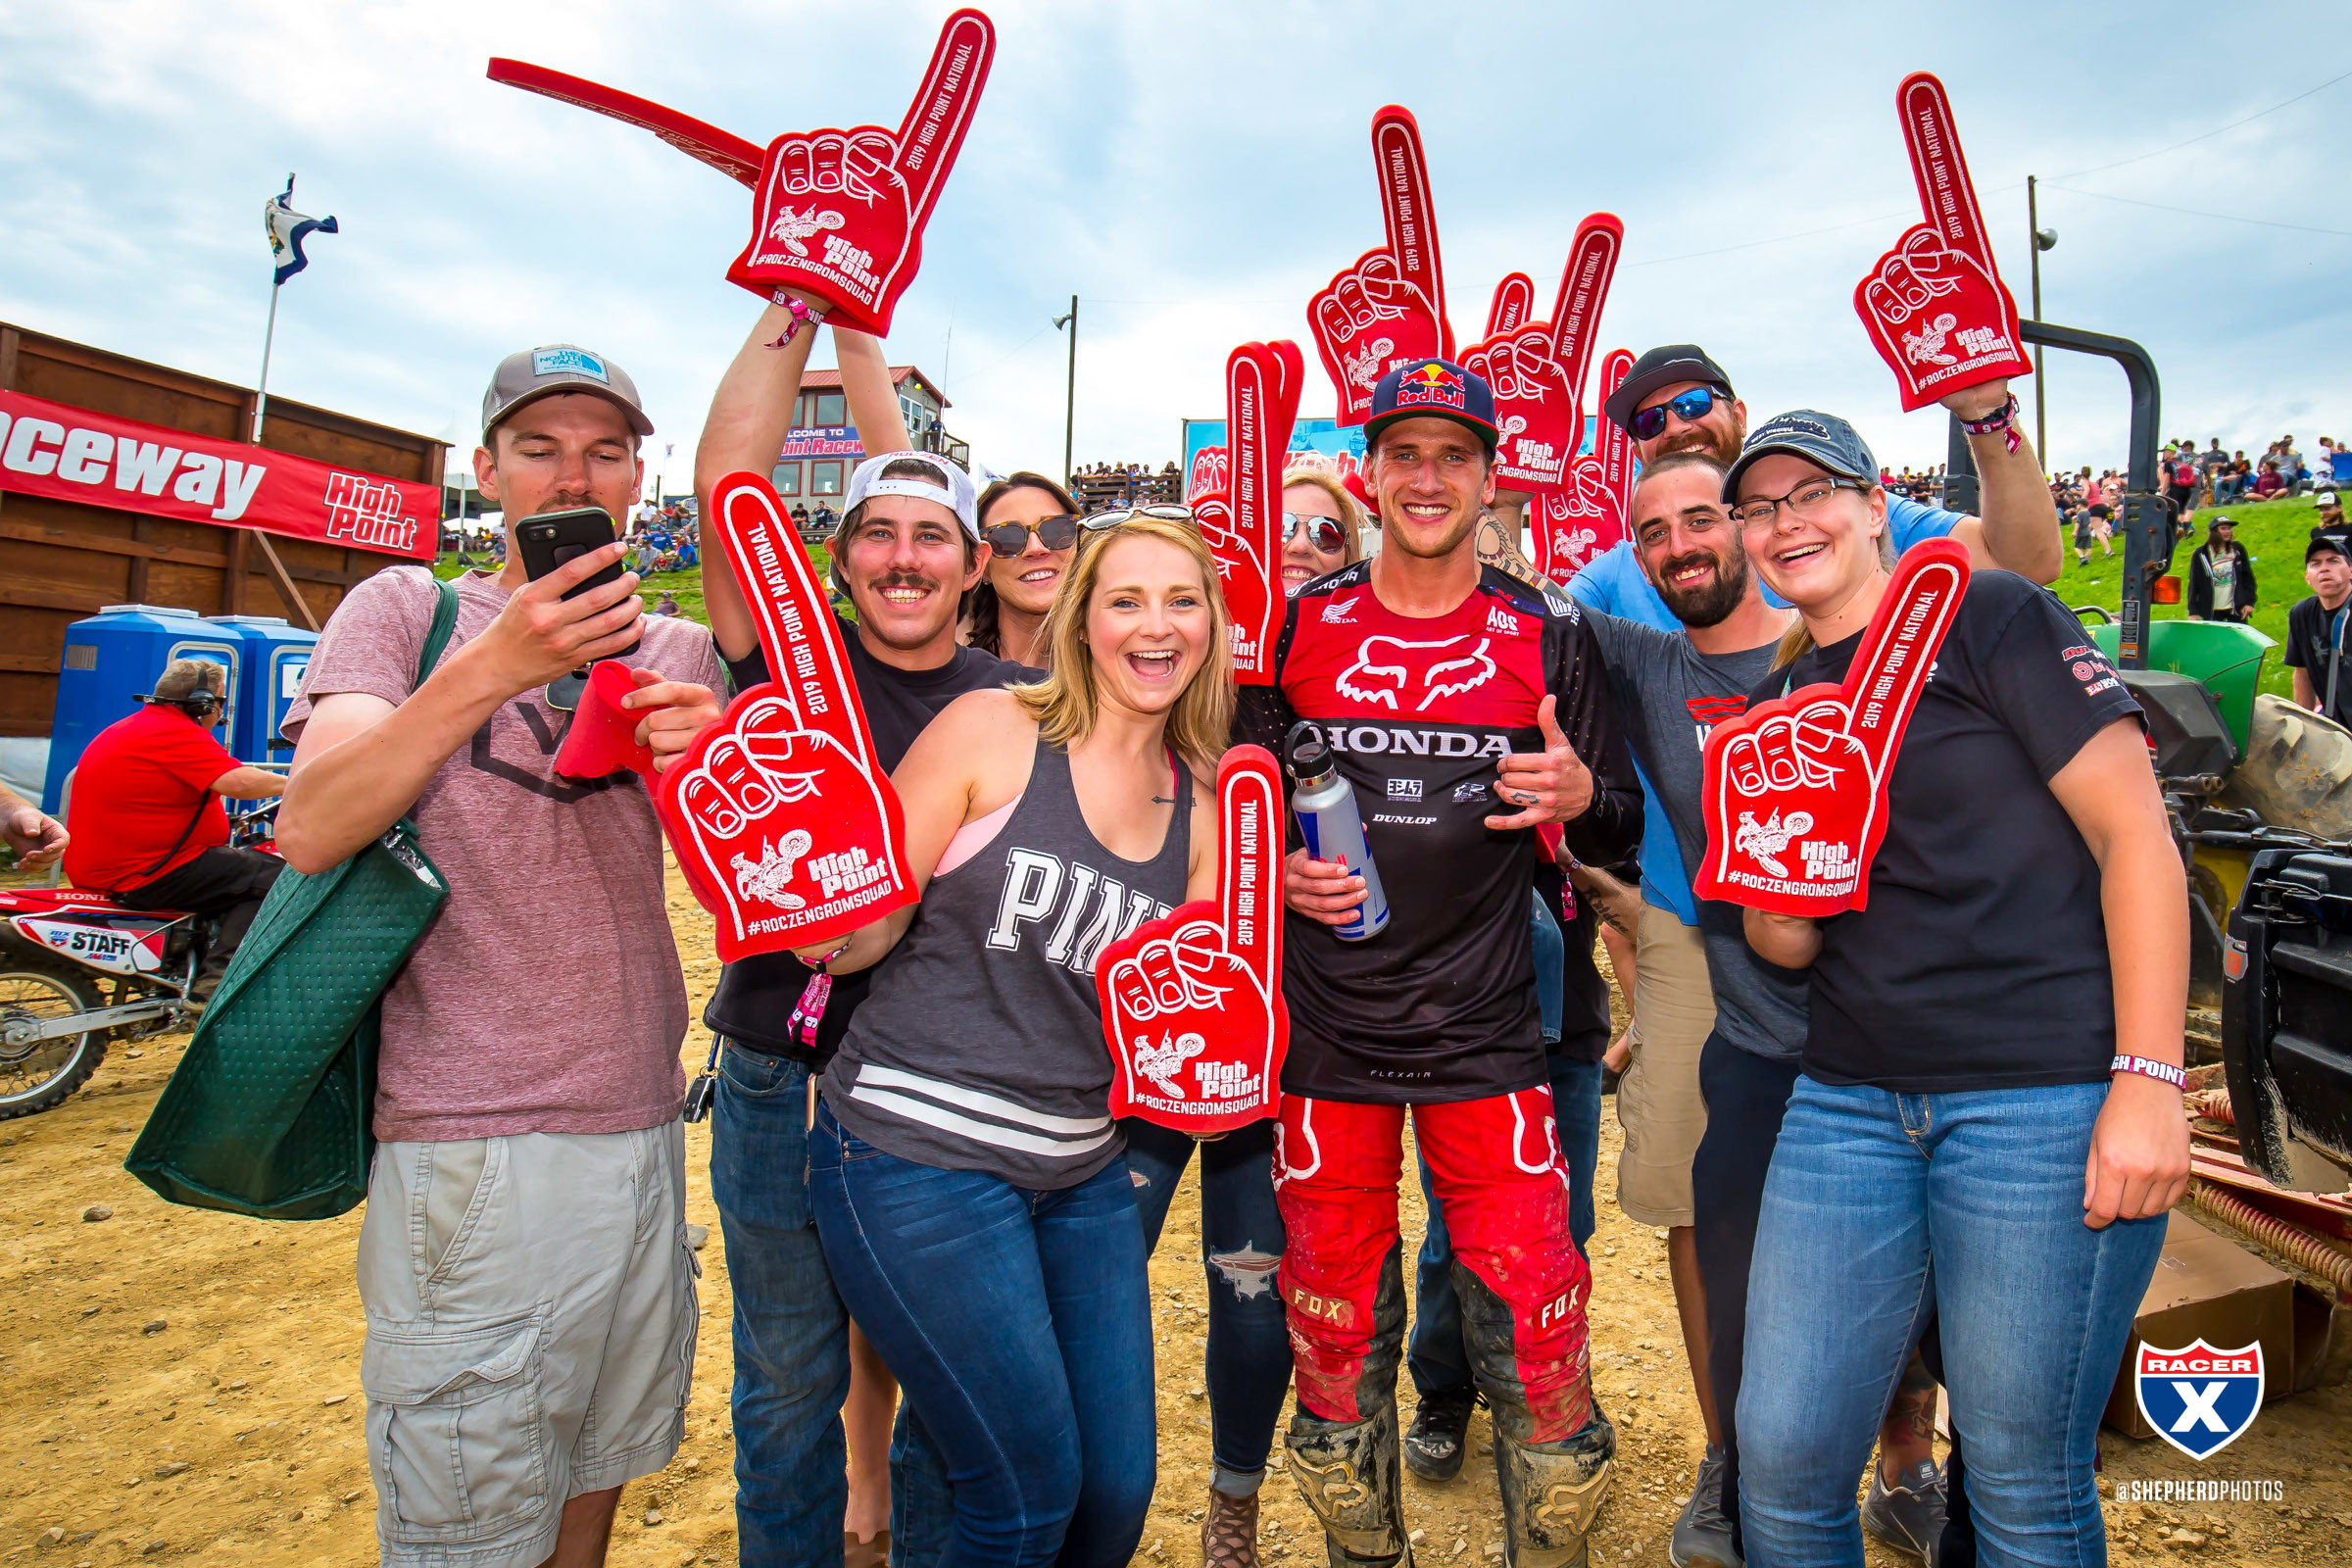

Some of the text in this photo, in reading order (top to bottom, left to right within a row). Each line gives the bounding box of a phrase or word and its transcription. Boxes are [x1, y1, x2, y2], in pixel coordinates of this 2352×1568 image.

[906, 43, 972, 171] 2019 HIGH POINT NATIONAL
[1920, 106, 1964, 239] 2019 HIGH POINT NATIONAL
[1391, 145, 1419, 271] 2019 HIGH POINT NATIONAL
[823, 233, 874, 270] High
[756, 253, 873, 306] #ROCZENGROMSQUAD
[822, 250, 880, 292] Point
[772, 290, 786, 306] 19
[1561, 250, 1602, 357] 2019 HIGH POINT NATIONAL
[1503, 302, 1519, 331] TIONAL
[1955, 325, 1995, 347] High
[1965, 335, 2011, 357] Point
[1918, 350, 2016, 390] #ROCZENGROMSQUAD
[1397, 388, 1464, 410] Red Bull
[787, 428, 845, 438] LCOME TO
[1515, 438, 1554, 459] High
[0, 411, 267, 521] ceway
[1241, 386, 1254, 529] 2019 HIGH POINT NATIONAL
[1518, 452, 1562, 472] Point
[1612, 441, 1621, 462] HIGH
[1497, 465, 1557, 483] ENGROMSQUAD
[1610, 463, 1619, 482] 2019
[323, 471, 402, 516] High
[326, 508, 417, 552] Point
[747, 521, 829, 715] 2019 HIGH POINT NATIONAL
[1486, 606, 1519, 632] AOS
[1897, 589, 1938, 641] NATIONAL
[1232, 639, 1257, 657] int
[1884, 642, 1911, 674] POINT
[1870, 674, 1895, 701] HIGH
[1860, 702, 1884, 729] 2019
[1309, 725, 1513, 759] HONDA
[1372, 813, 1437, 825] DUNLOP
[808, 846, 869, 882] High
[1799, 841, 1848, 864] High
[820, 857, 888, 900] Point
[1238, 800, 1257, 947] 2019 HIGH POINT NATIONAL
[1727, 870, 1854, 898] #ROCZENGROMSQUAD
[1805, 858, 1857, 880] Point
[747, 879, 893, 937] #ROCZENGROMSQUAD
[986, 847, 1174, 977] PIN
[71, 931, 131, 956] STAFF
[1195, 1060, 1249, 1083] High
[2112, 1054, 2186, 1086] GH POINT
[1201, 1074, 1260, 1100] Point
[1135, 1092, 1260, 1117] #ROCZENGROMSQUAD
[1294, 1288, 1343, 1319] FOX
[1541, 1284, 1580, 1331] FOX
